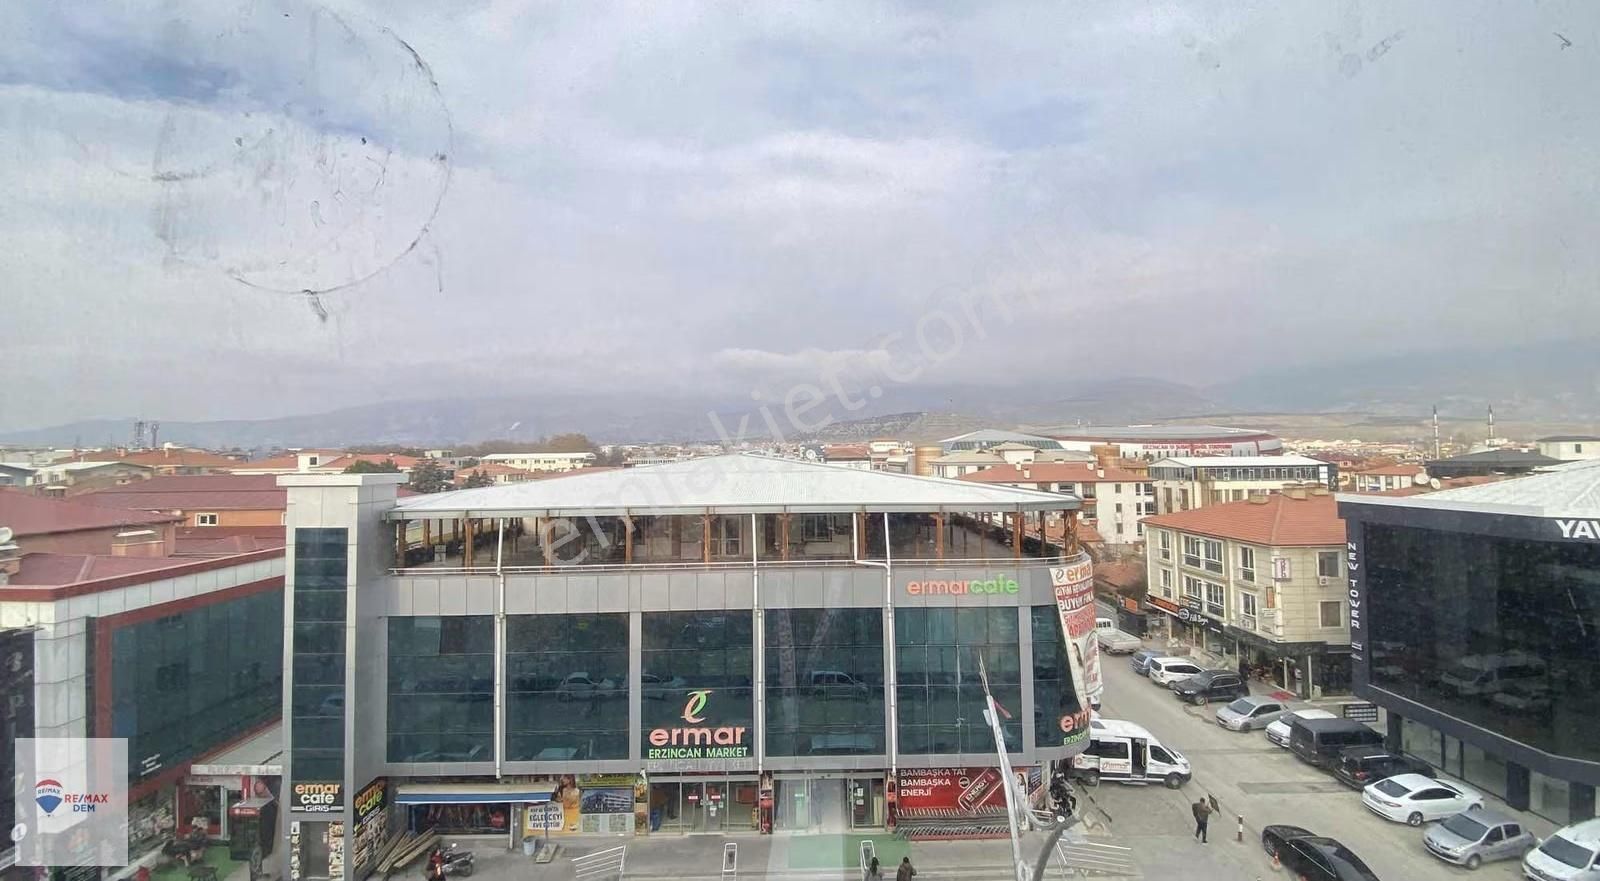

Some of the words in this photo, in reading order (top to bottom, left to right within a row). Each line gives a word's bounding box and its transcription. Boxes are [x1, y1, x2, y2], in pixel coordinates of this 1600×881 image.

[1347, 542, 1359, 571] NEW
[1349, 579, 1361, 630] TOWER
[649, 727, 745, 746] ermar
[648, 747, 701, 759] ERZINCAN
[706, 747, 748, 758] MARKET
[900, 768, 951, 777] BAMBAŞKA
[952, 768, 967, 776] TAT
[900, 778, 951, 787] BAMBAŞKA
[295, 784, 340, 794] ermar
[901, 787, 932, 797] ENERJİ
[300, 791, 335, 804] cafe
[359, 791, 383, 816] cafe
